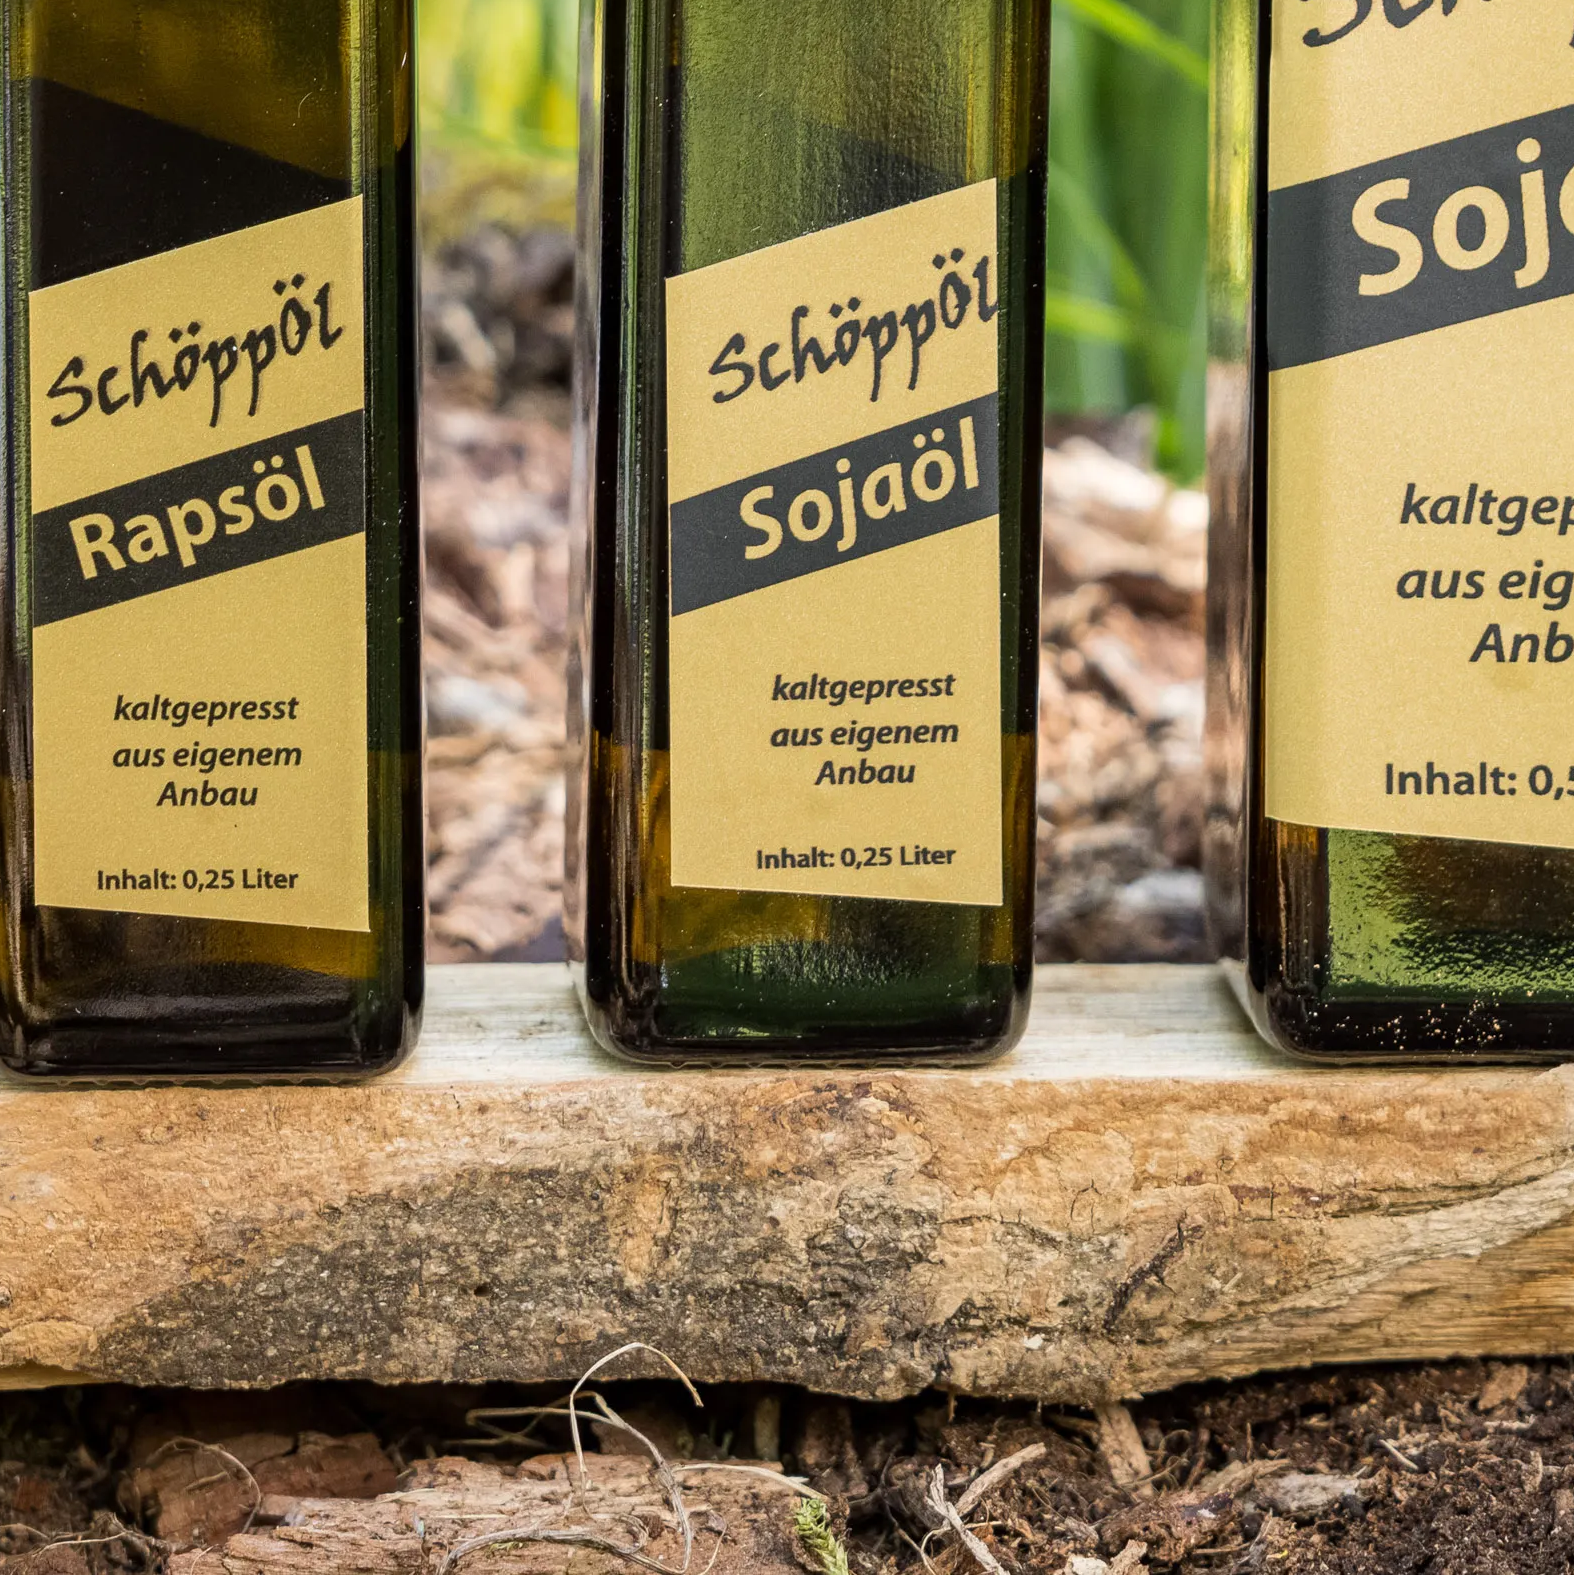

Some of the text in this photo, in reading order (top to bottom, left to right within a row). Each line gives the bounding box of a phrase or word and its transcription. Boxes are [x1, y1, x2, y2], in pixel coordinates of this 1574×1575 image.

[740, 416, 979, 559] Sojaöl
[69, 445, 325, 579] Rapsöl
[1397, 570, 1485, 599] aus
[772, 673, 956, 706] kaltgepresst
[114, 694, 299, 727] kaltgepresst
[770, 720, 958, 752] aus eigenem
[113, 741, 301, 774] aus eigenem
[815, 758, 915, 785] Anbau
[156, 780, 258, 806] Anbau
[1386, 762, 1516, 796] Inhalt:
[757, 845, 956, 870] Inhalt: 0,25 Liter
[98, 868, 298, 892] Inhalt: 0,25 Liter
